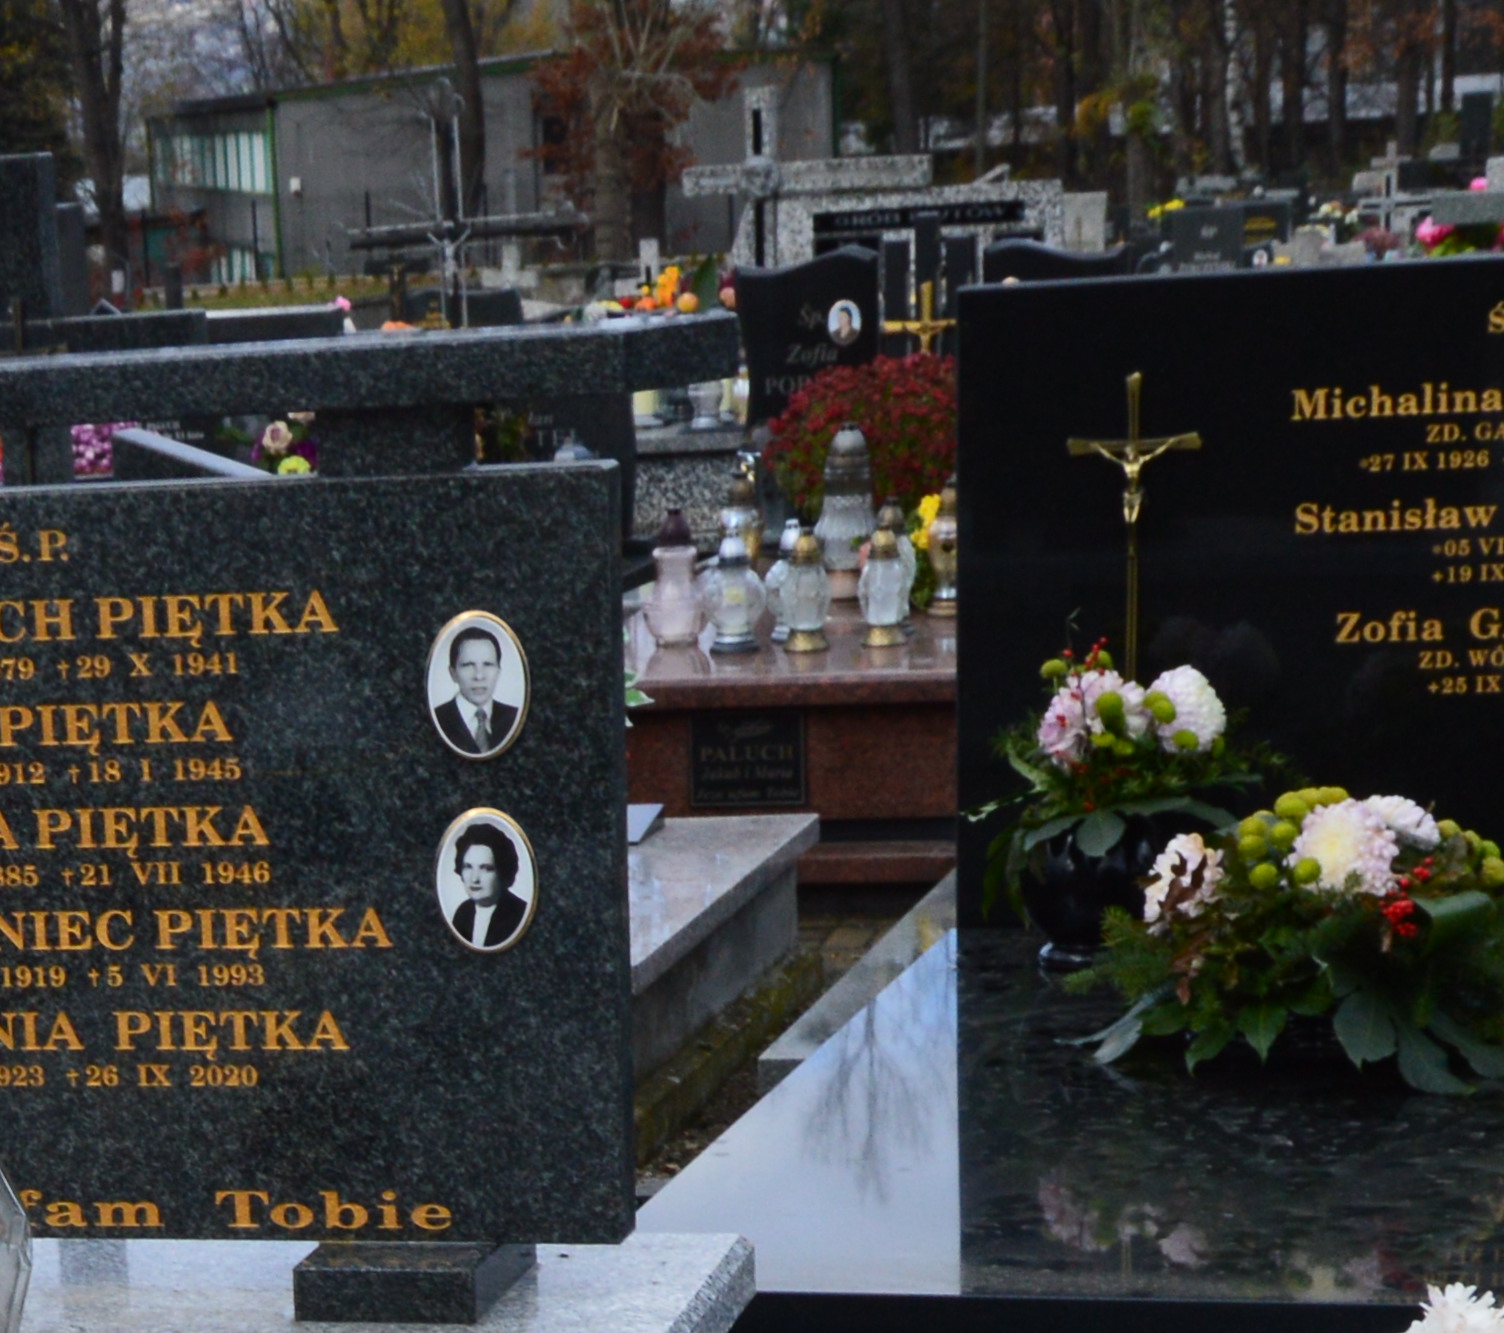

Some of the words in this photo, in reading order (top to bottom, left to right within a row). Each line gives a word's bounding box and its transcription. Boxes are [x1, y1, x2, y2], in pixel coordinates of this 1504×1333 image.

[1292, 382, 1504, 422] Michalina
[1370, 454, 1394, 472] 27
[1403, 452, 1428, 470] IX
[1438, 450, 1489, 469] 1926
[1295, 498, 1497, 535] Stanisław
[1444, 539, 1470, 556] 05
[1479, 537, 1504, 555] VI
[1481, 564, 1504, 581] IX
[96, 591, 339, 648] PIĘTKA
[1336, 611, 1443, 643] Zofia
[77, 656, 110, 678] 29
[131, 654, 151, 676] X
[175, 653, 238, 676] 1941
[1476, 675, 1501, 693] IX
[699, 743, 794, 762] PALUCH
[91, 760, 121, 782] 18
[175, 758, 241, 780] 1945
[33, 806, 269, 858] PIĘTKA
[81, 864, 110, 885] 21
[131, 862, 180, 885] VII
[203, 862, 270, 884] 1946
[154, 908, 392, 959] PIĘTKA
[2, 966, 65, 987] 1919
[109, 966, 123, 986] 5
[142, 964, 176, 986] VI
[199, 964, 264, 986] 1993
[115, 1011, 350, 1060] PIĘTKA
[86, 1065, 118, 1086] 26
[138, 1065, 171, 1086] IX
[190, 1065, 258, 1087] 2020
[216, 1191, 450, 1230] Tobie
